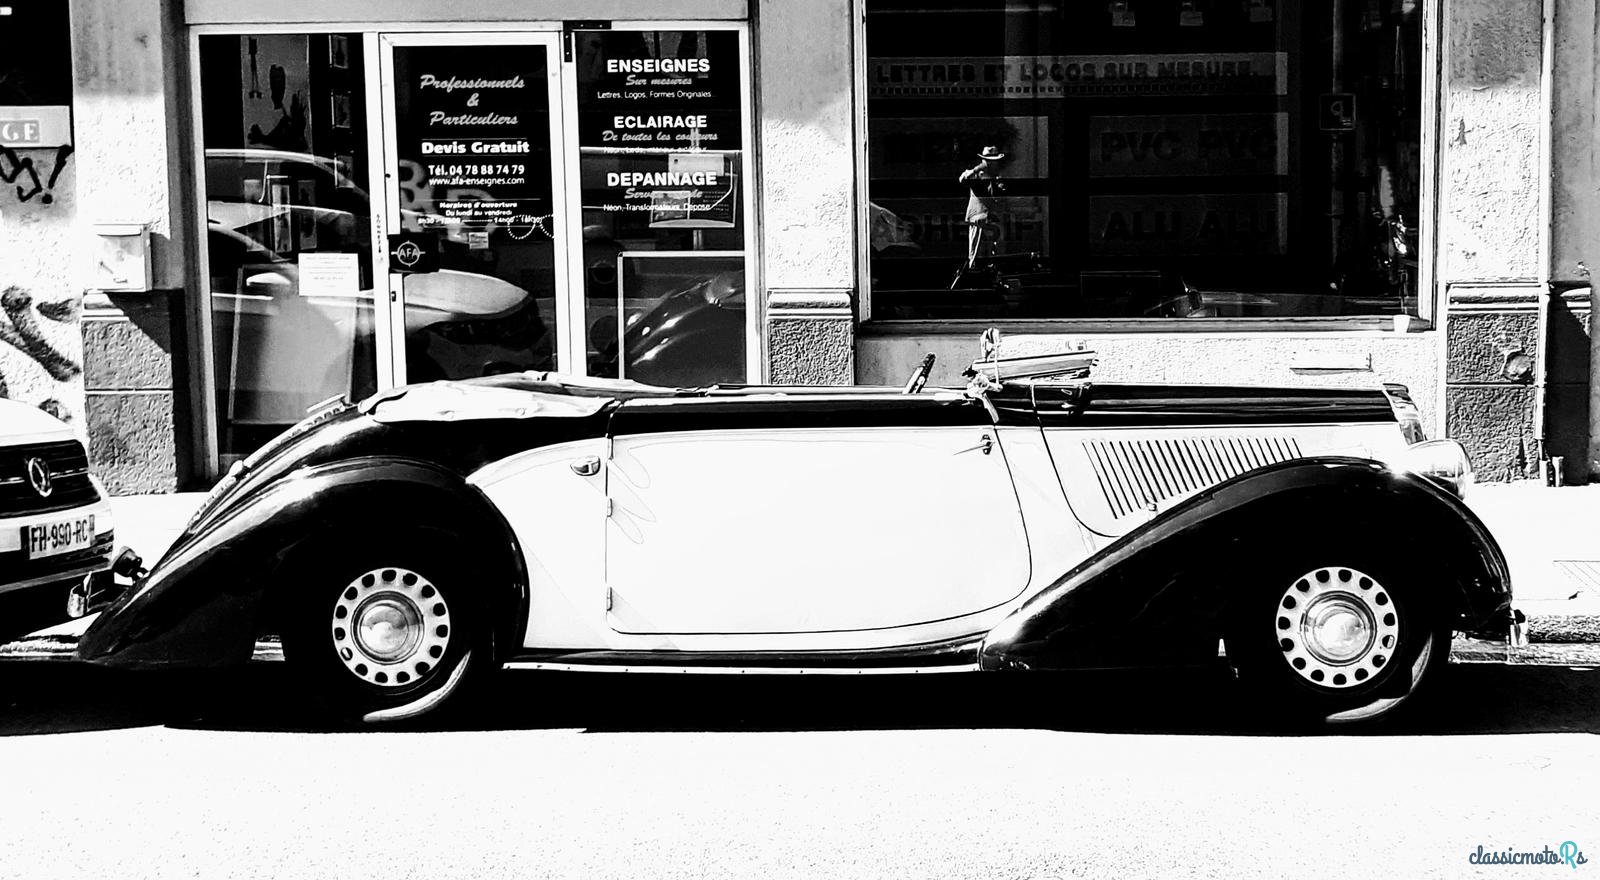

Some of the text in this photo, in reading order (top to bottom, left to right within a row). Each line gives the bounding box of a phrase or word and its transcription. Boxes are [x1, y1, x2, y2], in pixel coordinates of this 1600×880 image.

[607, 59, 711, 73] ENSEIGNES
[876, 63, 976, 82] LETTRES
[1020, 62, 1097, 82] LOGOS
[420, 74, 525, 93] Professionnels
[625, 74, 692, 86] Sur mesures
[466, 92, 480, 107] &
[649, 90, 676, 98] Formes
[676, 90, 712, 99] Originales
[429, 111, 518, 126] Particuliers
[614, 115, 707, 129] ECLAIRAGE
[602, 130, 618, 142] De
[622, 131, 652, 141] toutes
[656, 131, 671, 141] les
[421, 141, 530, 154] Devis Gratuit
[1100, 131, 1184, 162] PVC
[449, 164, 463, 176] 04
[465, 164, 479, 175] 78
[480, 164, 494, 175] 88
[495, 164, 510, 175] 74
[511, 164, 525, 175] 79
[428, 175, 525, 187] www.afa-enseignes.com
[606, 172, 717, 187] DEPANNAGE
[1103, 210, 1182, 243] ALU
[399, 247, 418, 258] AFA
